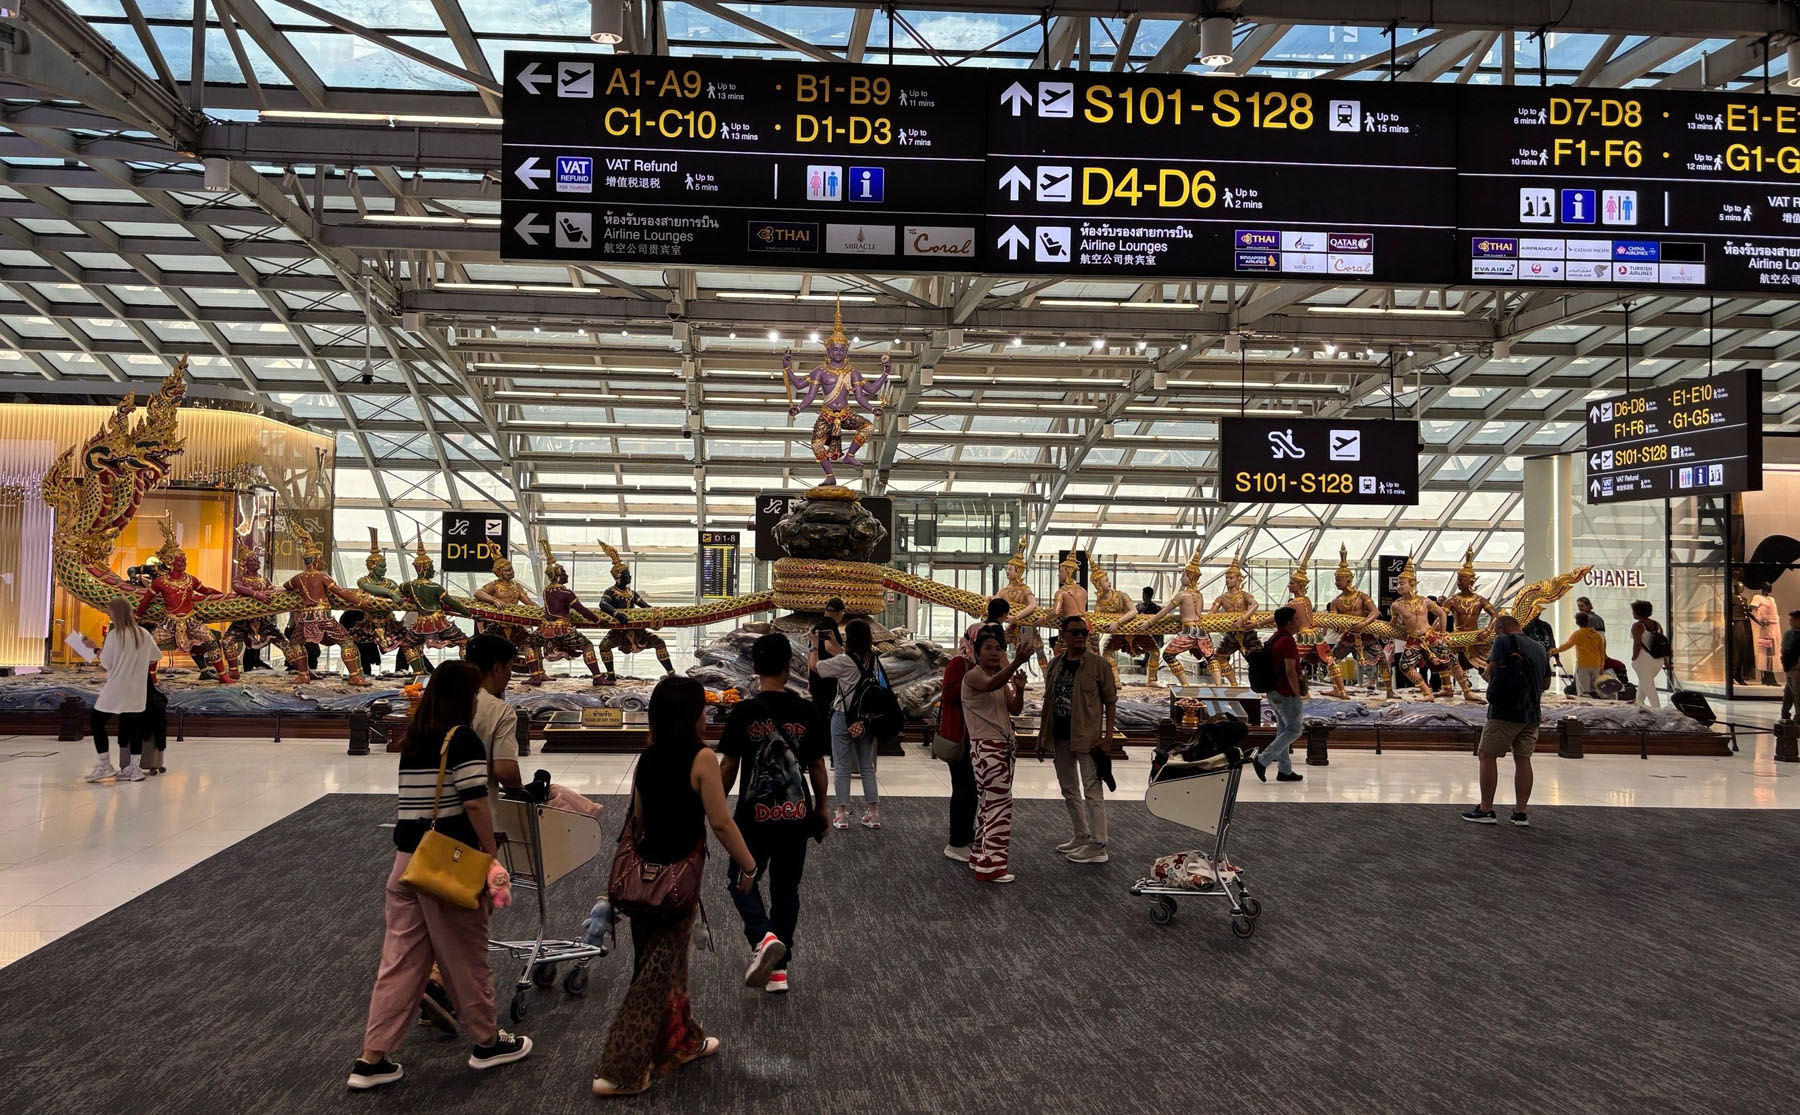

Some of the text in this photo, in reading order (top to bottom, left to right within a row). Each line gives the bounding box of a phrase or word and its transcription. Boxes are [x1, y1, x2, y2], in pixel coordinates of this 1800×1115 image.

[605, 68, 702, 98] A1-A9
[718, 82, 727, 91] Up
[796, 74, 891, 105] B1-B9
[909, 90, 919, 99] Up
[1084, 85, 1314, 130] S101-S128
[1518, 107, 1528, 116] Up
[1550, 98, 1642, 128] D7-D8
[1377, 113, 1399, 124] Up to
[1514, 116, 1519, 124] 6
[1695, 113, 1705, 121] Up
[1727, 104, 1800, 133] E1-E
[604, 107, 716, 139] C1-C10
[731, 123, 741, 132] Up
[796, 114, 892, 145] D1-D3
[909, 129, 918, 138] Up
[1377, 125, 1409, 133] 15 mins
[741, 133, 759, 141] mins
[1519, 148, 1529, 157] Up
[1554, 138, 1642, 168] F1-F6
[1694, 154, 1704, 162] Up
[561, 160, 589, 173] VAT
[606, 159, 677, 173] VAT Refund
[1521, 158, 1537, 166] mins
[1696, 163, 1712, 171] mins
[605, 176, 661, 189] 增值税退税
[695, 173, 705, 182] Up
[1082, 167, 1216, 208] D4-D6
[1235, 189, 1258, 199] Up to
[1235, 200, 1262, 209] 2 mins
[1767, 196, 1790, 207] VAT
[1723, 205, 1733, 213] Up
[1724, 214, 1741, 222] mins
[603, 229, 694, 243] Airline Lounges
[776, 230, 810, 241] THAI
[1252, 235, 1275, 243] THAI
[913, 233, 972, 253] Coral
[1080, 240, 1168, 254] Airline Lounges
[1330, 238, 1357, 248] QATAR
[1490, 243, 1512, 251] THAI
[603, 243, 681, 256] 航空公司贵宾室
[1080, 254, 1156, 265] 航空公司贵宾室
[1748, 258, 1783, 269] Airline
[1334, 259, 1371, 272] Coral
[1673, 384, 1712, 406] E1-E10
[1614, 398, 1645, 417] D6-D8
[1673, 409, 1709, 429] G1-G5
[1614, 420, 1644, 439] F1-F6
[1615, 444, 1667, 466] S101-S128
[1235, 472, 1353, 493] S101-S128
[1584, 570, 1645, 587] CHANEL
